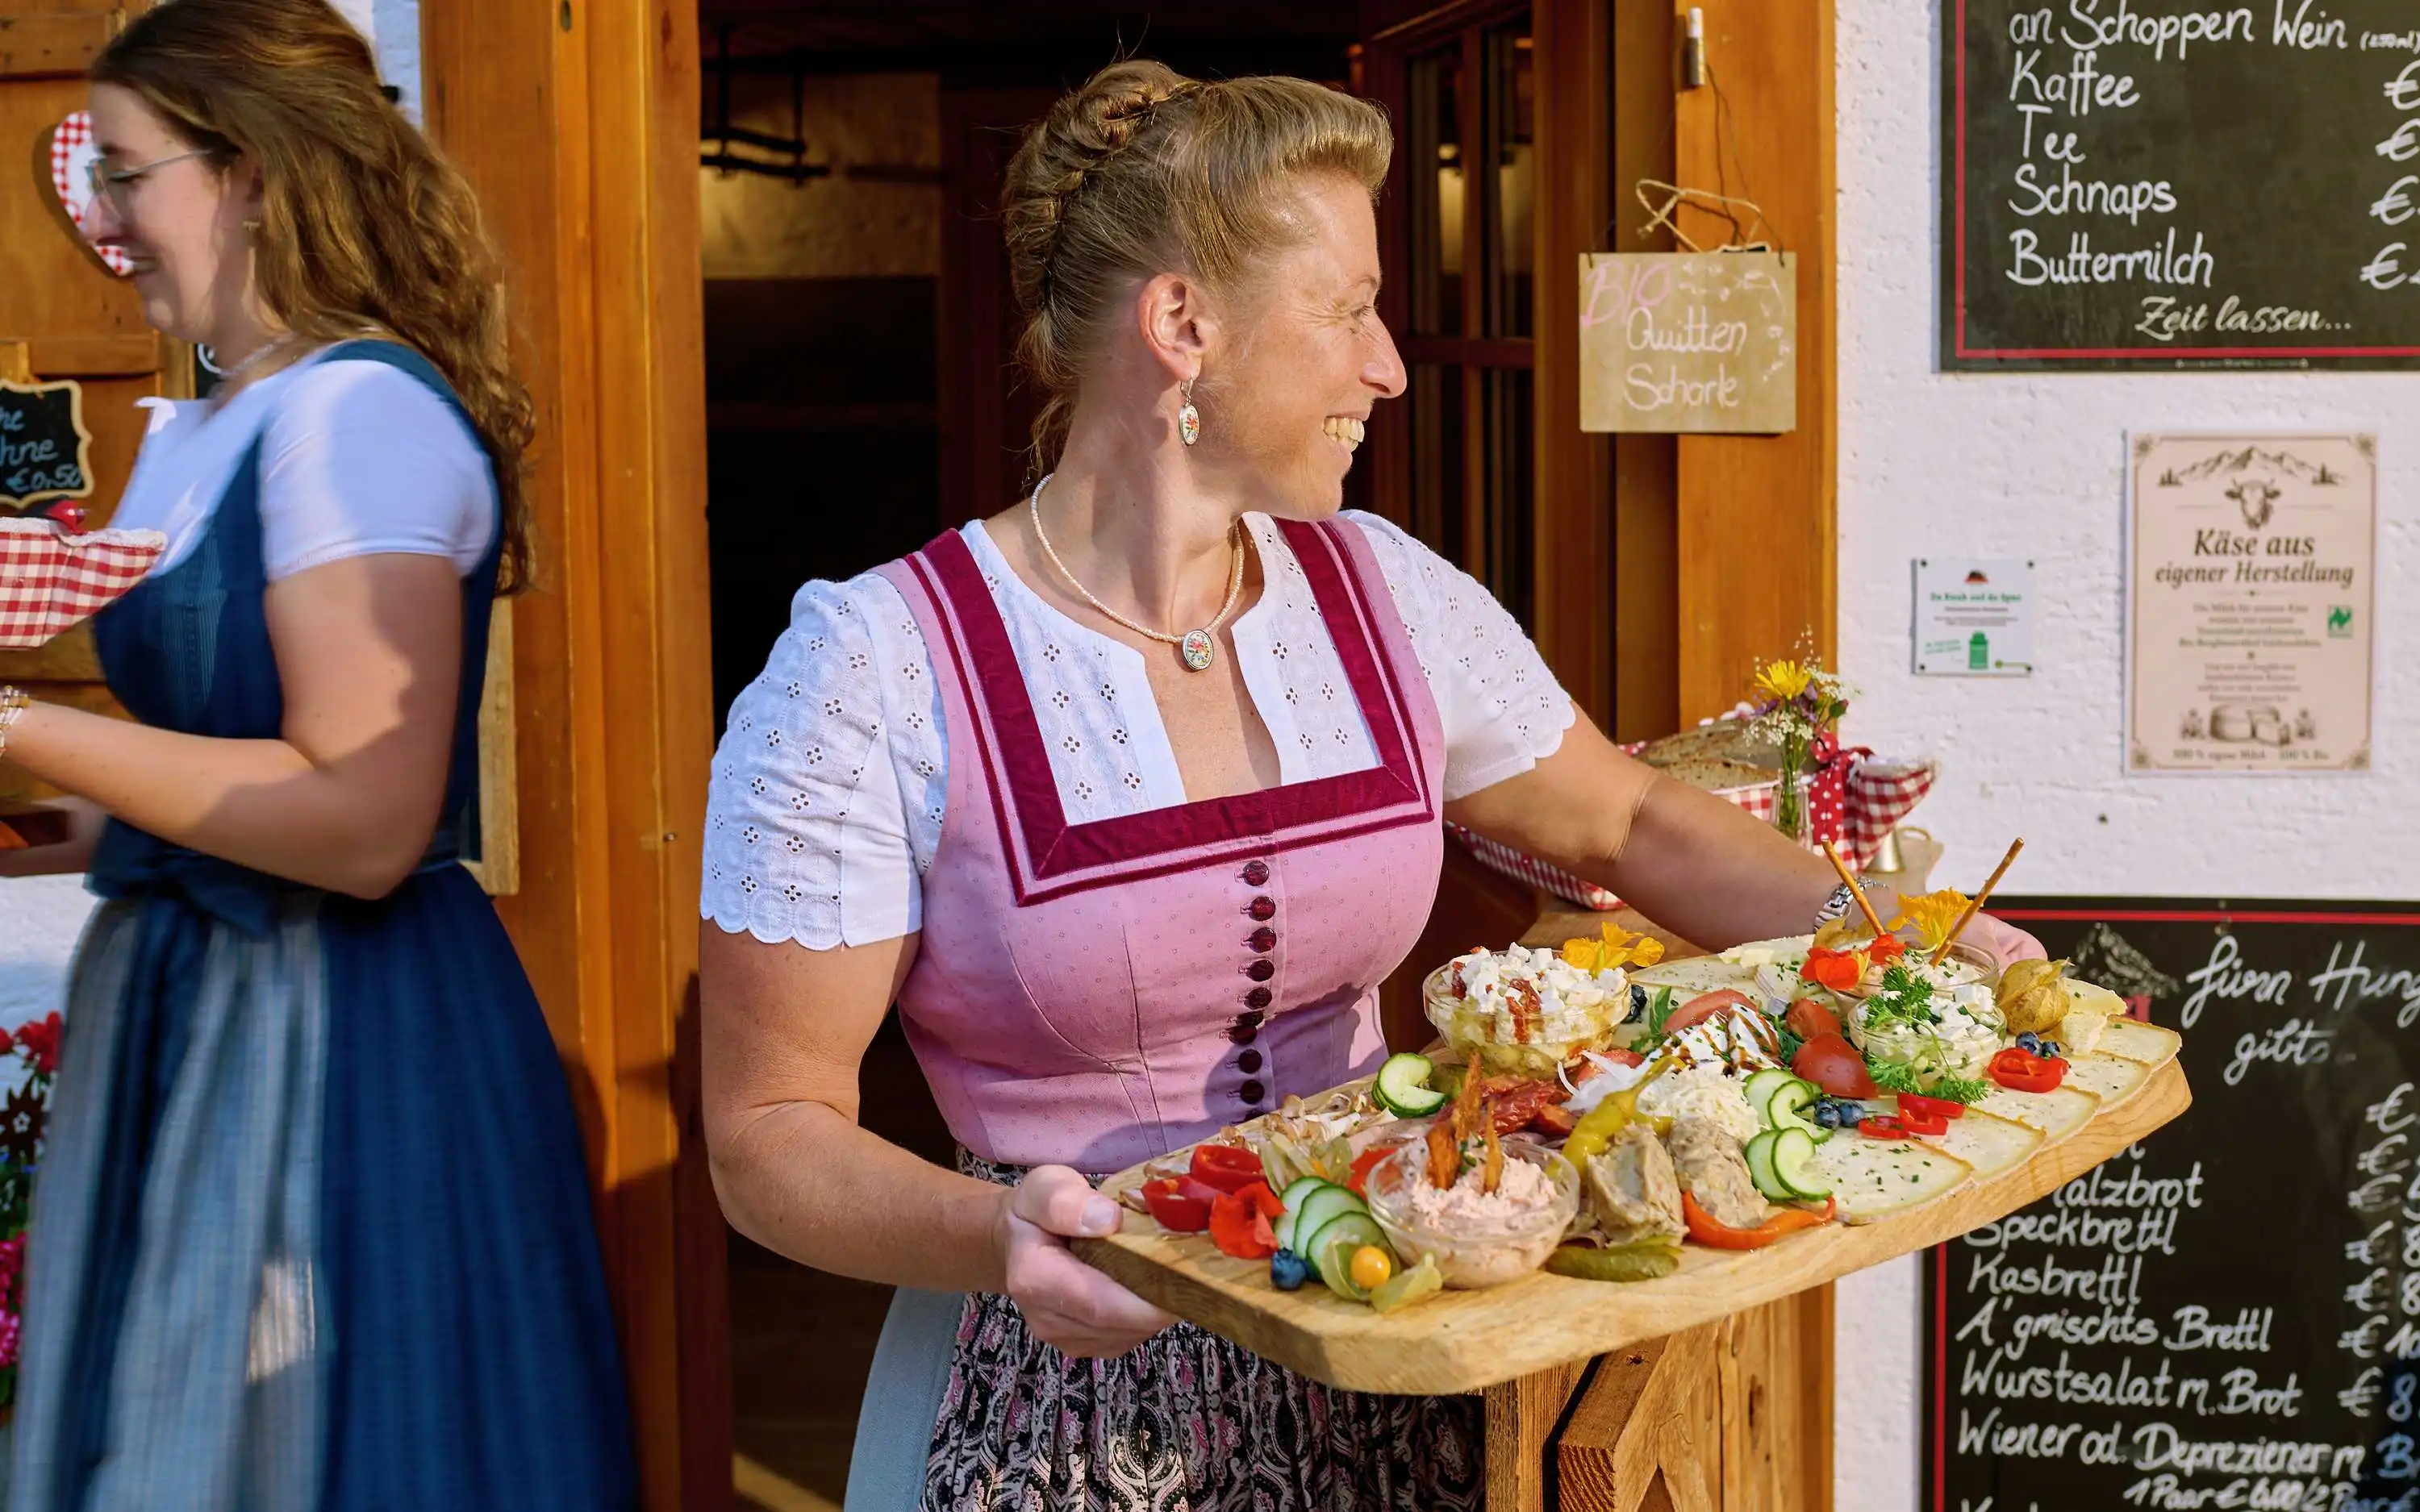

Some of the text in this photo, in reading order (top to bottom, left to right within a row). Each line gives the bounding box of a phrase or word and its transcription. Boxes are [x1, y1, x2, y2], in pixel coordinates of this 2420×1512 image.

[2009, 7, 2054, 44] an
[2060, 0, 2255, 61] Schoppen
[2272, 0, 2348, 50] Wein
[2009, 48, 2140, 116] Kaffee
[2017, 104, 2086, 162] Tee
[2008, 164, 2177, 226] Schnaps
[2005, 227, 2213, 288] Buttermilch
[1579, 260, 1671, 329] BIO
[2134, 295, 2351, 341] Zeit lassen...
[1626, 305, 1748, 356] Quitten
[2194, 528, 2314, 557] Käse aus
[2155, 561, 2355, 589] eigener Herstellung
[2053, 1161, 2205, 1208] alzbrot
[1967, 1252, 2143, 1305] Kasbrettl
[2163, 1305, 2273, 1352] Brettl
[1960, 1349, 2171, 1404] Wurstsalat
[1958, 1408, 2081, 1458] Wiener
